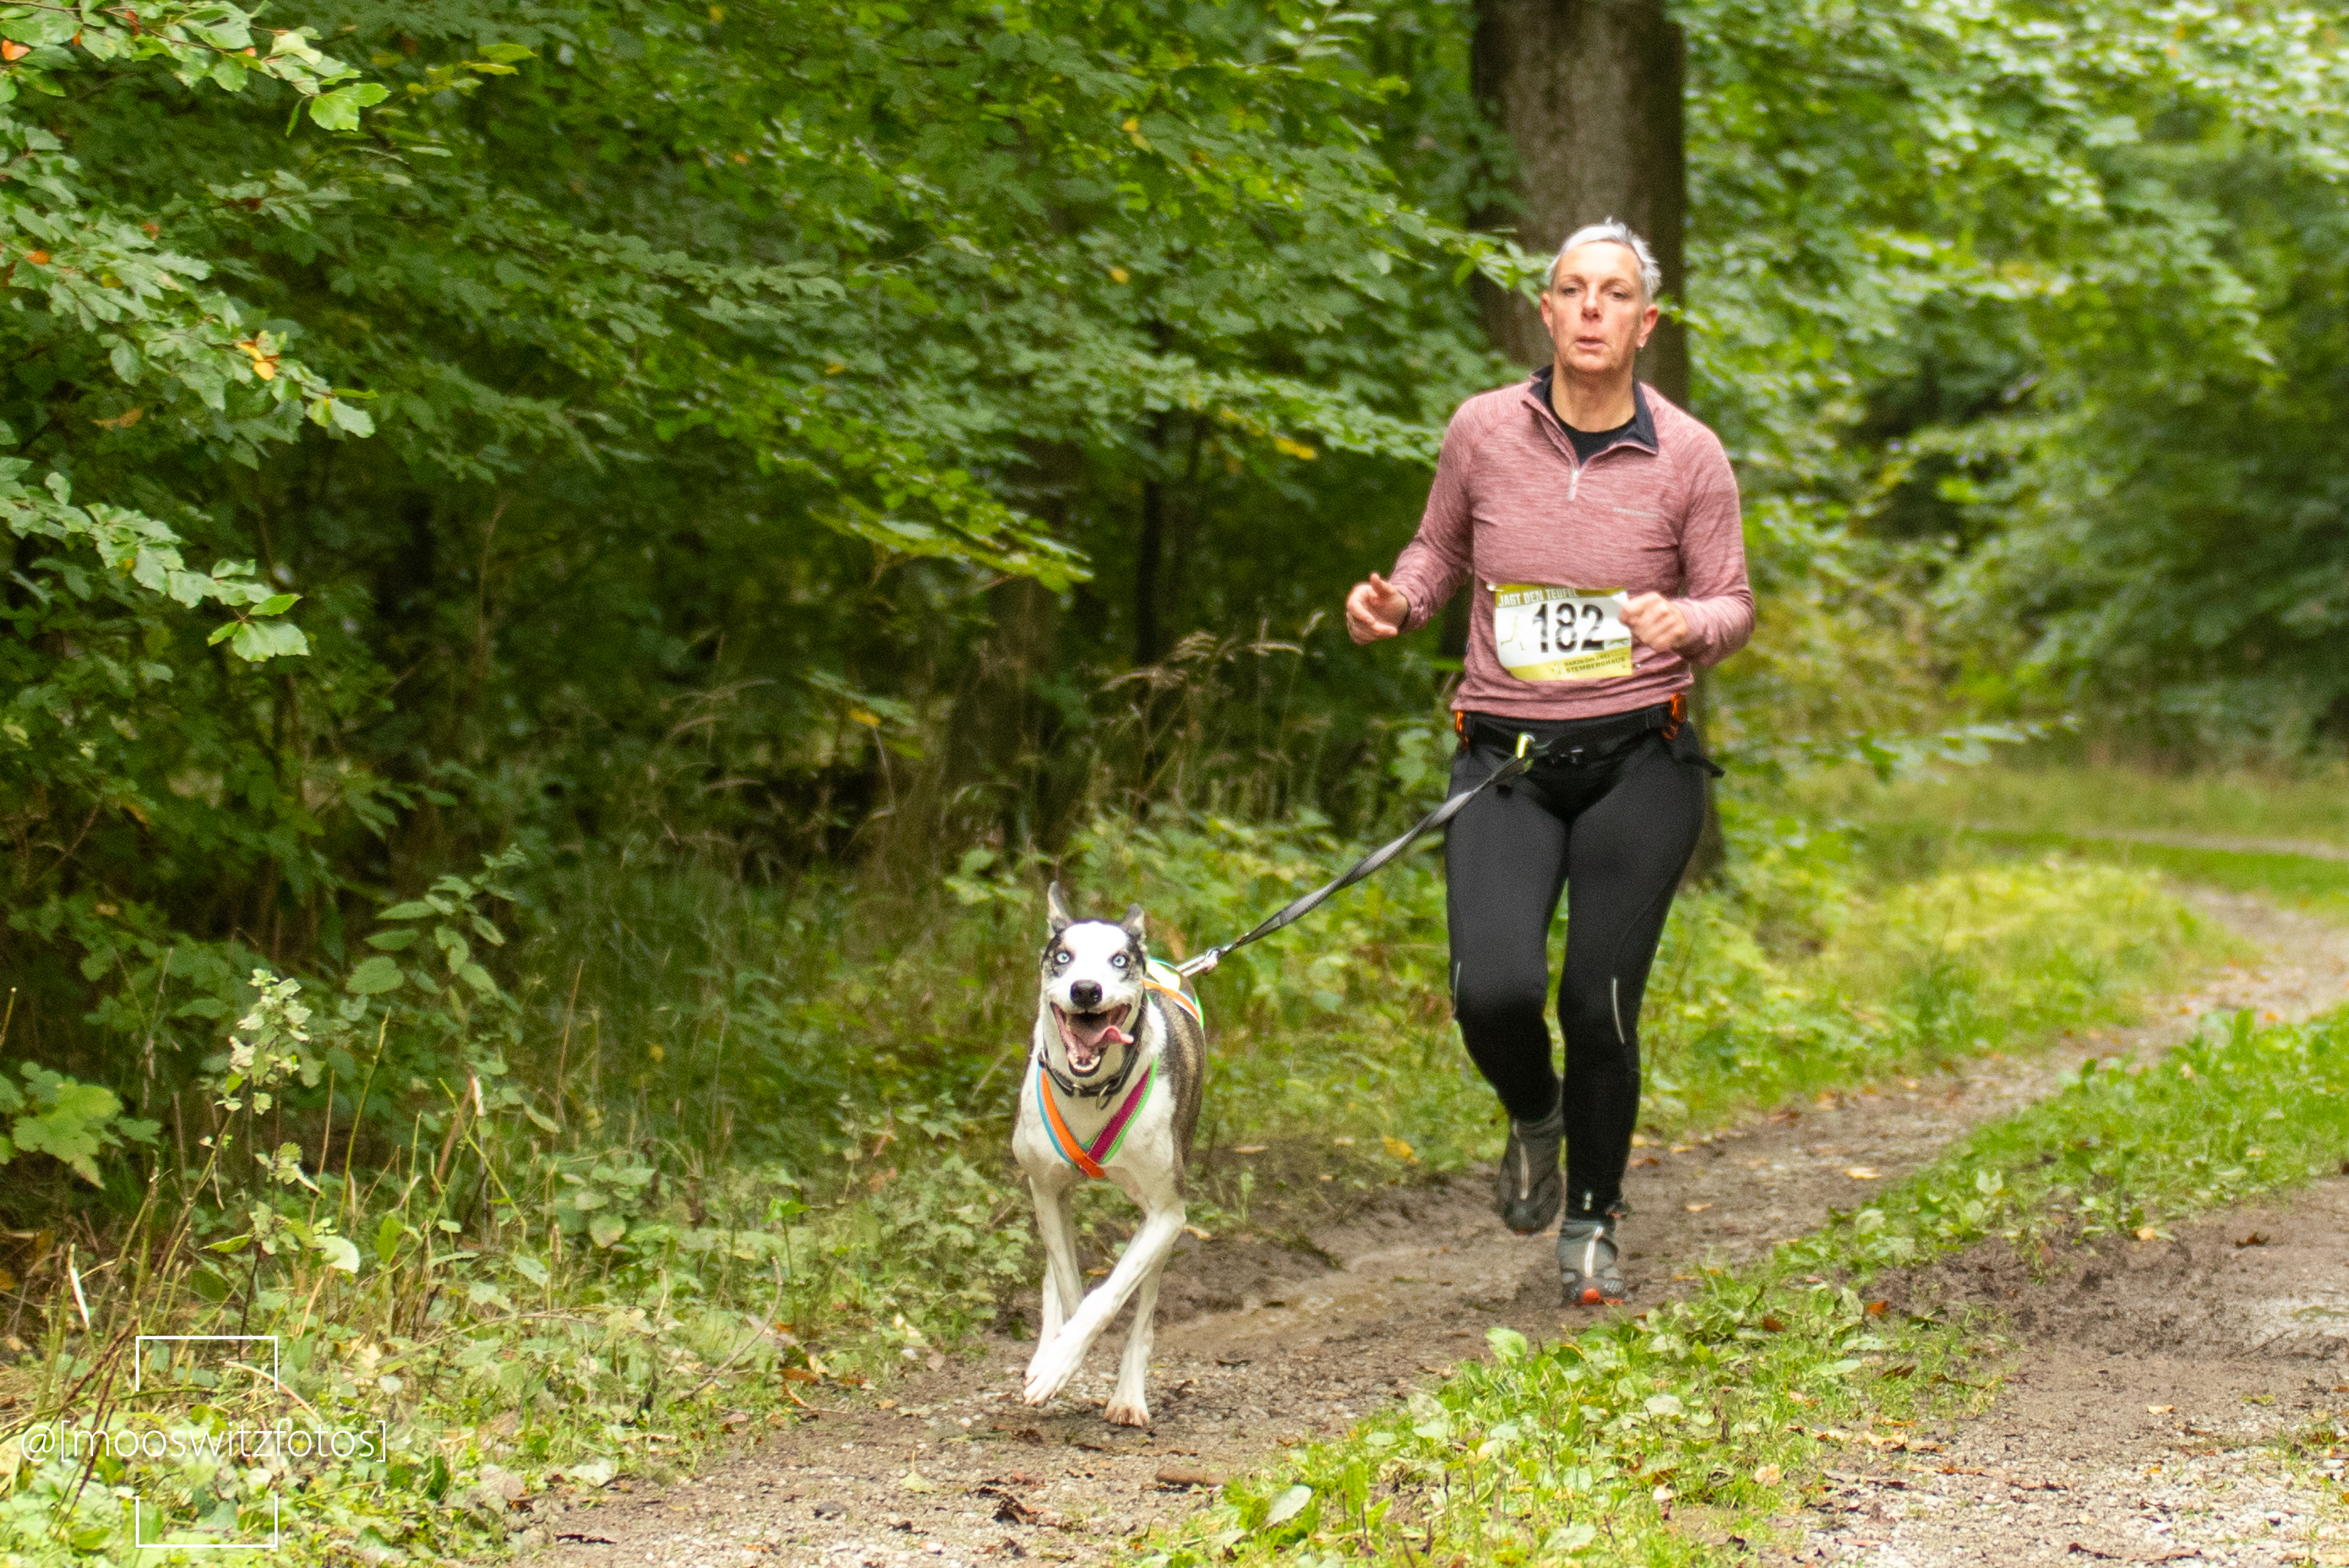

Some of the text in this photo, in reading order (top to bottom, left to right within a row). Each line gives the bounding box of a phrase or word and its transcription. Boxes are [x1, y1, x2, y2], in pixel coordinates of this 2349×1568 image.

[1498, 587, 1579, 607] JAGT DEN TEUFEL
[1533, 602, 1605, 653] 182
